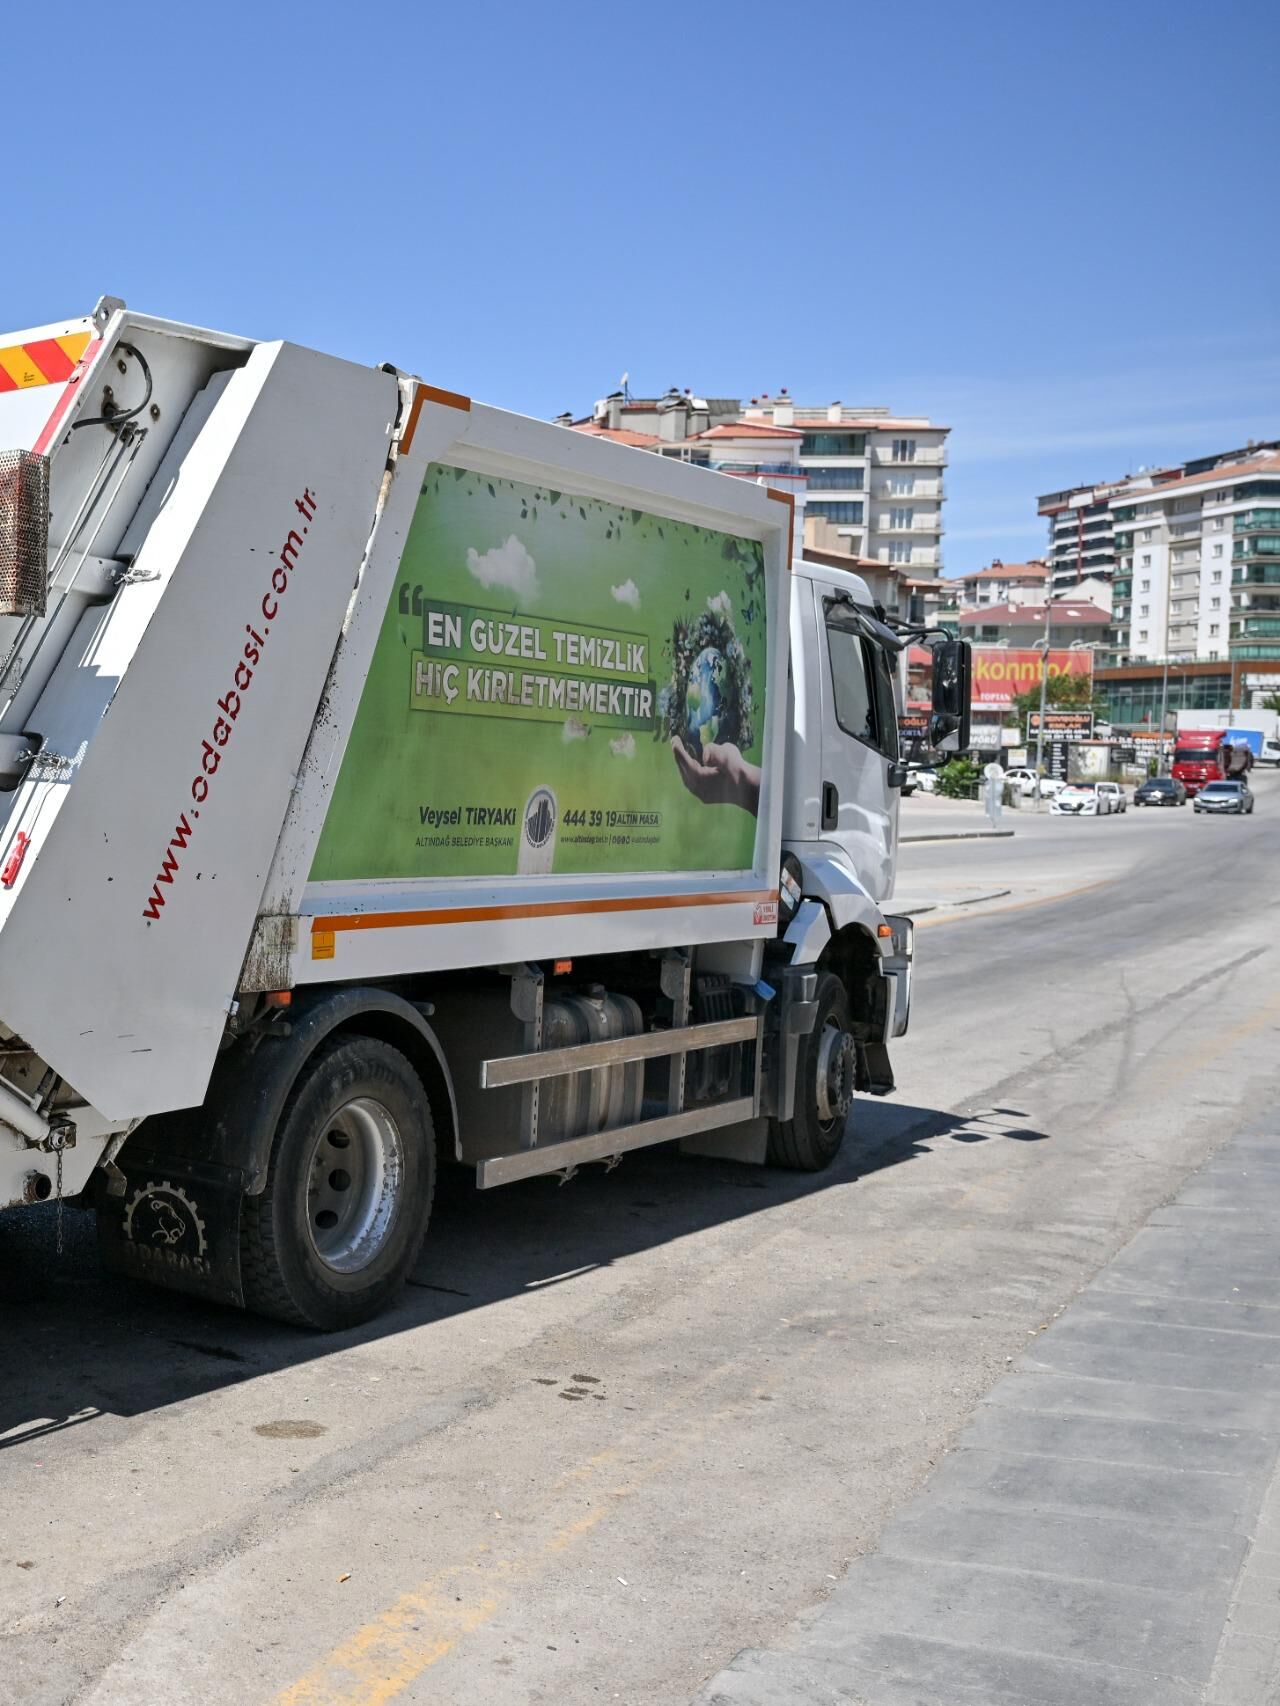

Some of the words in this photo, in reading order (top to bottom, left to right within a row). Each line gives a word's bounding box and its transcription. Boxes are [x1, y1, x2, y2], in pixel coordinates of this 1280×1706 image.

[427, 611, 463, 649] EN
[469, 618, 547, 661] GÜZEL
[552, 630, 646, 674] TEMİZLİK
[415, 660, 460, 705] HİÇ
[466, 667, 653, 718] KİRLETMEMEKTİR
[142, 487, 318, 921] www.odabasi.com.tr
[419, 806, 462, 829] Veysel
[465, 807, 517, 826] TİRYAKİ
[562, 809, 586, 827] 444
[588, 809, 603, 827] 39
[605, 810, 617, 827] 19
[616, 813, 638, 825] ALTIN
[415, 834, 450, 847] ALTINDAĞ
[451, 835, 484, 847] BELEDİYE
